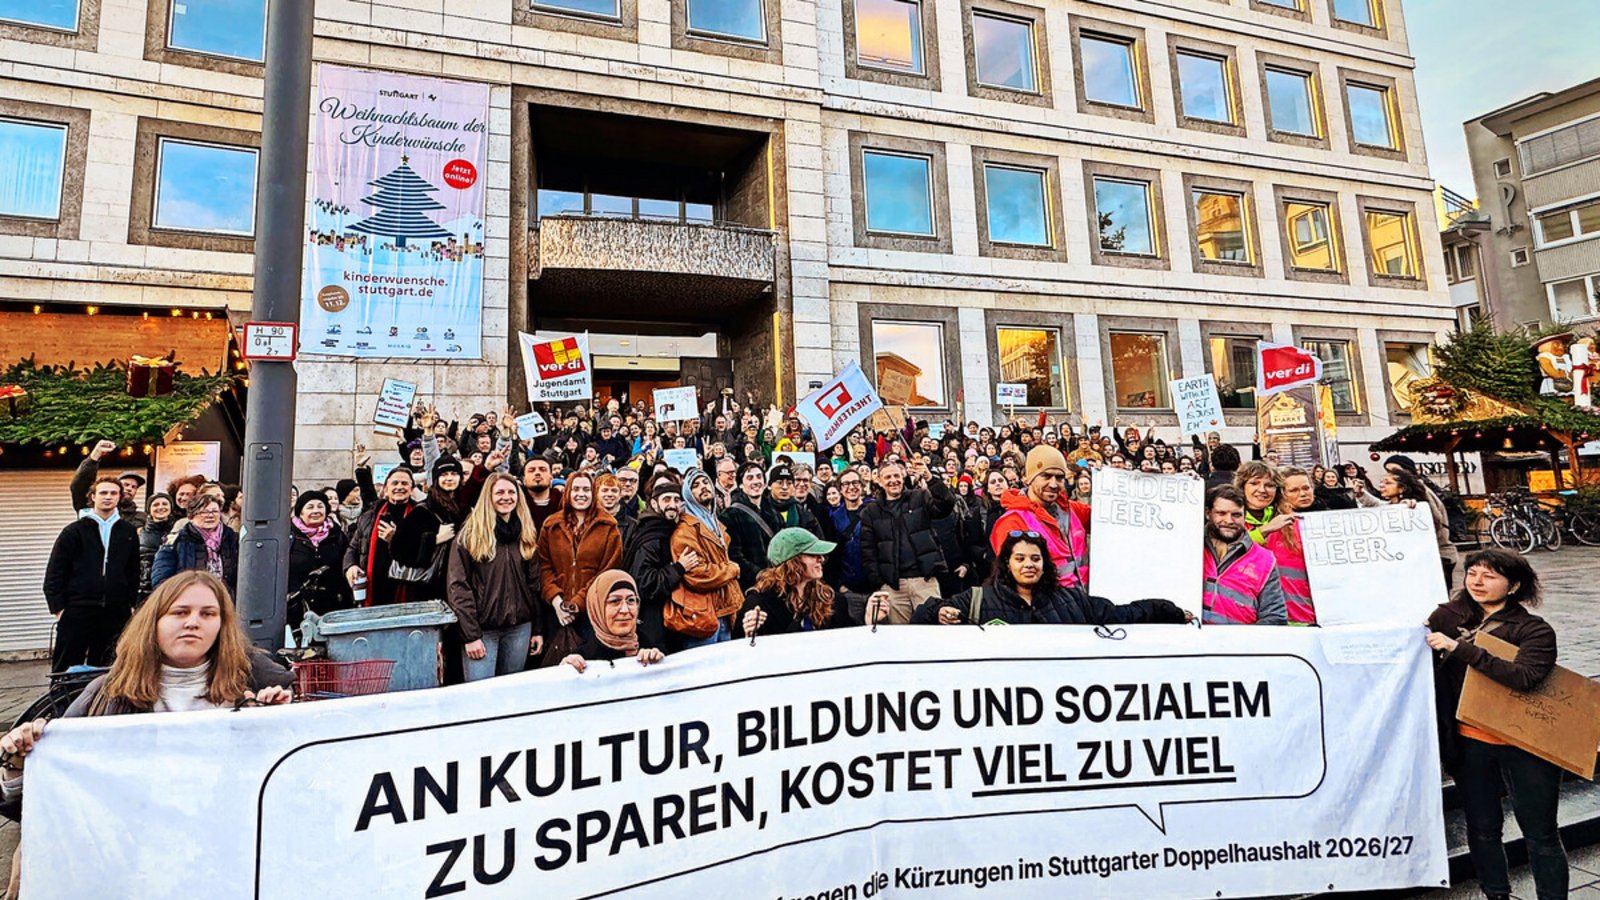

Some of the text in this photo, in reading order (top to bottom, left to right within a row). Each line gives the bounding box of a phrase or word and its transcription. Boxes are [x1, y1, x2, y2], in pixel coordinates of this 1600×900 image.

[379, 90, 418, 100] STUTTGART
[319, 97, 487, 134] Weihnachtsbaum der
[340, 124, 466, 153] Kinderwünsche
[445, 173, 474, 184] online!
[343, 271, 449, 287] kinderwuensche.
[358, 285, 433, 298] stuttgart.de
[255, 326, 285, 336] H 90
[533, 377, 586, 390] Jugendamt
[540, 388, 582, 398] Stuttgart
[1178, 378, 1209, 392] EARTH
[1187, 397, 1210, 409] ART
[1094, 470, 1199, 505] LEIDER
[1094, 497, 1174, 531] LEER.
[1303, 507, 1430, 539] LEIDER
[1308, 536, 1405, 566] LEER.
[355, 681, 1270, 831] AN KULTUR, BILDUNG UND SOZIALEM
[426, 736, 1235, 899] ZU SPAREN, KOSTET VIEL ZU VIEL
[863, 871, 889, 898] die
[895, 865, 1014, 889] Kürzungen
[1019, 859, 1043, 879] im
[1049, 852, 1159, 877] Stuttgarter
[1164, 841, 1321, 870] Doppelhaushalt
[1326, 836, 1413, 858] 2026/27
